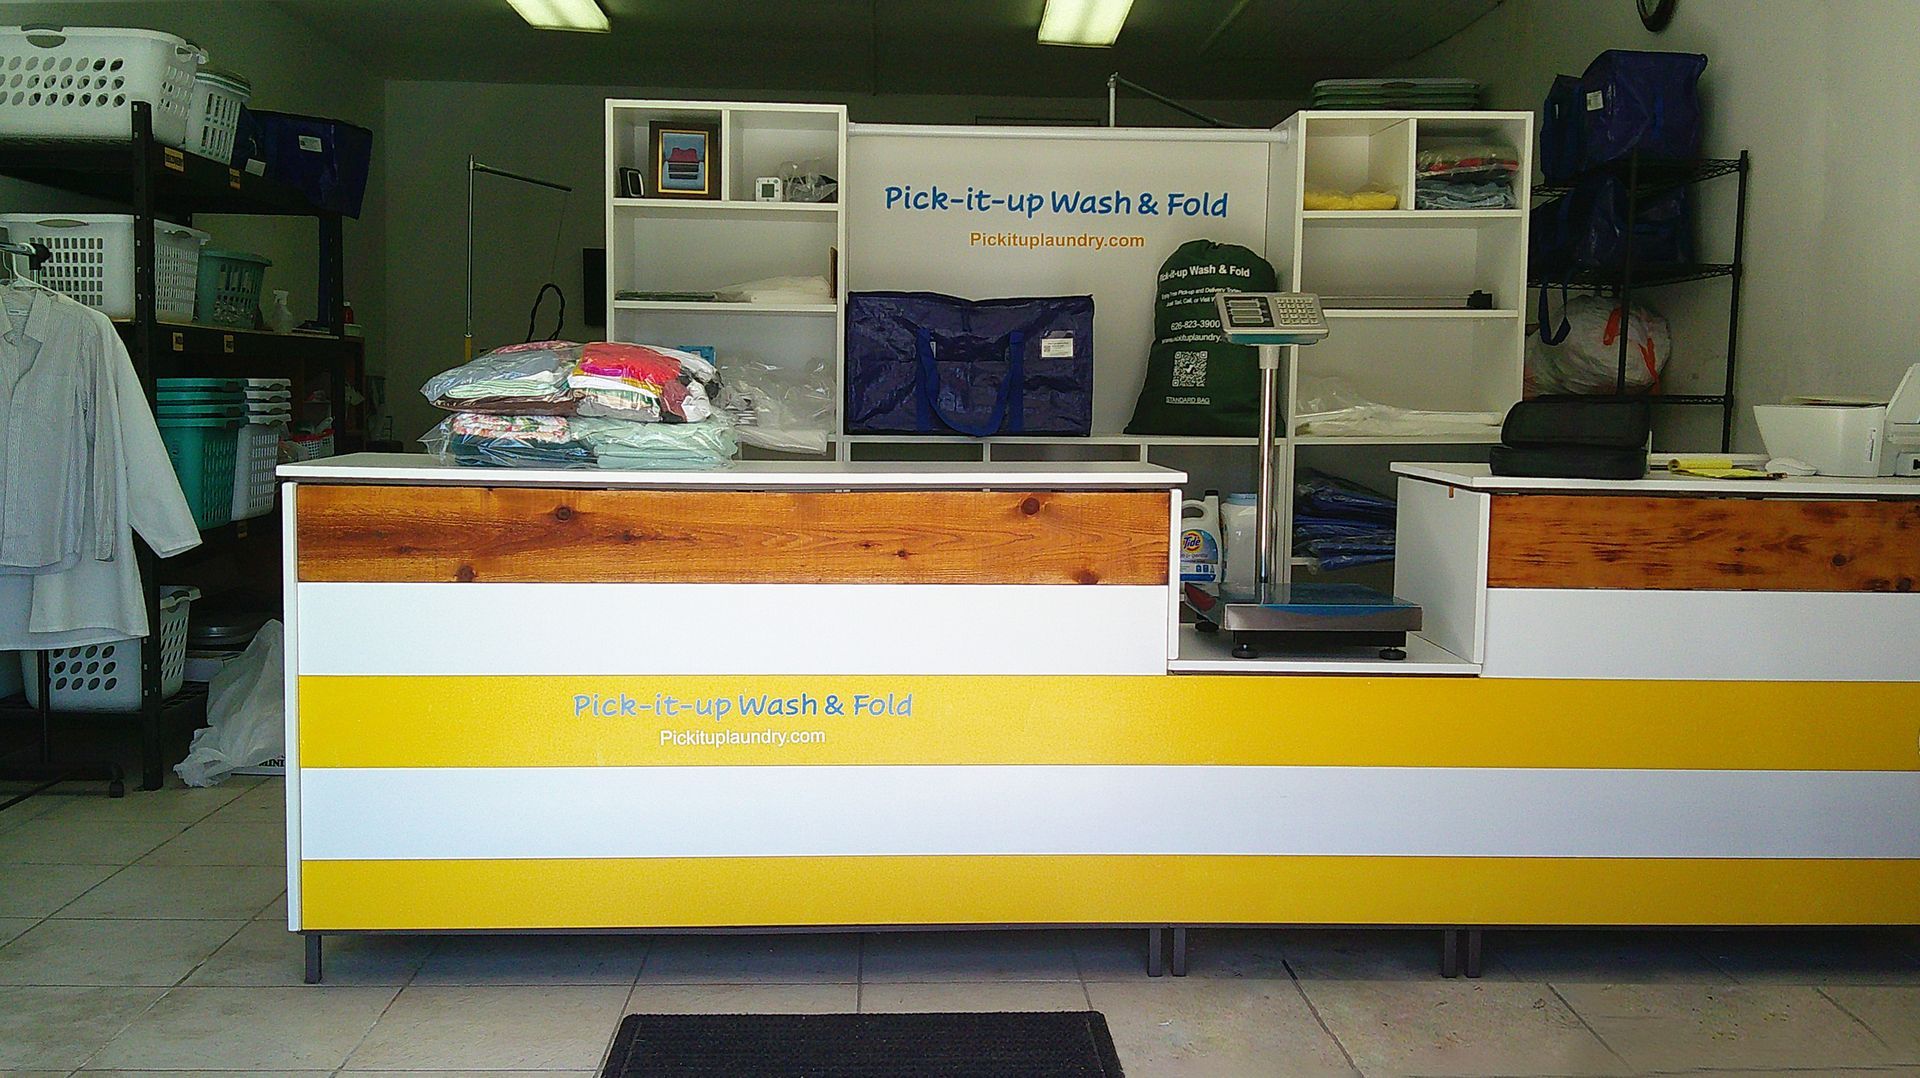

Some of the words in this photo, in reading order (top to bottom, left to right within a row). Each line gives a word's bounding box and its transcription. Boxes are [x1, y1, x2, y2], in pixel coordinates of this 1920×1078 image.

[884, 185, 1044, 218] Pick-it-up
[1051, 190, 1132, 215] Wash
[1137, 192, 1159, 216] &
[1167, 192, 1229, 218] Fold
[970, 232, 1145, 250] Pickituplaundry.com
[1189, 264, 1216, 276] Wash
[1218, 264, 1227, 274] &
[1229, 265, 1250, 277] Fold
[1170, 319, 1220, 330] 626-823-3900
[1183, 535, 1201, 549] Tide
[573, 693, 733, 721] Pick-it-up
[738, 692, 818, 717] Wash
[824, 694, 845, 717] &
[853, 693, 913, 717] Fold
[659, 730, 826, 748] Pickituplaundry.com
